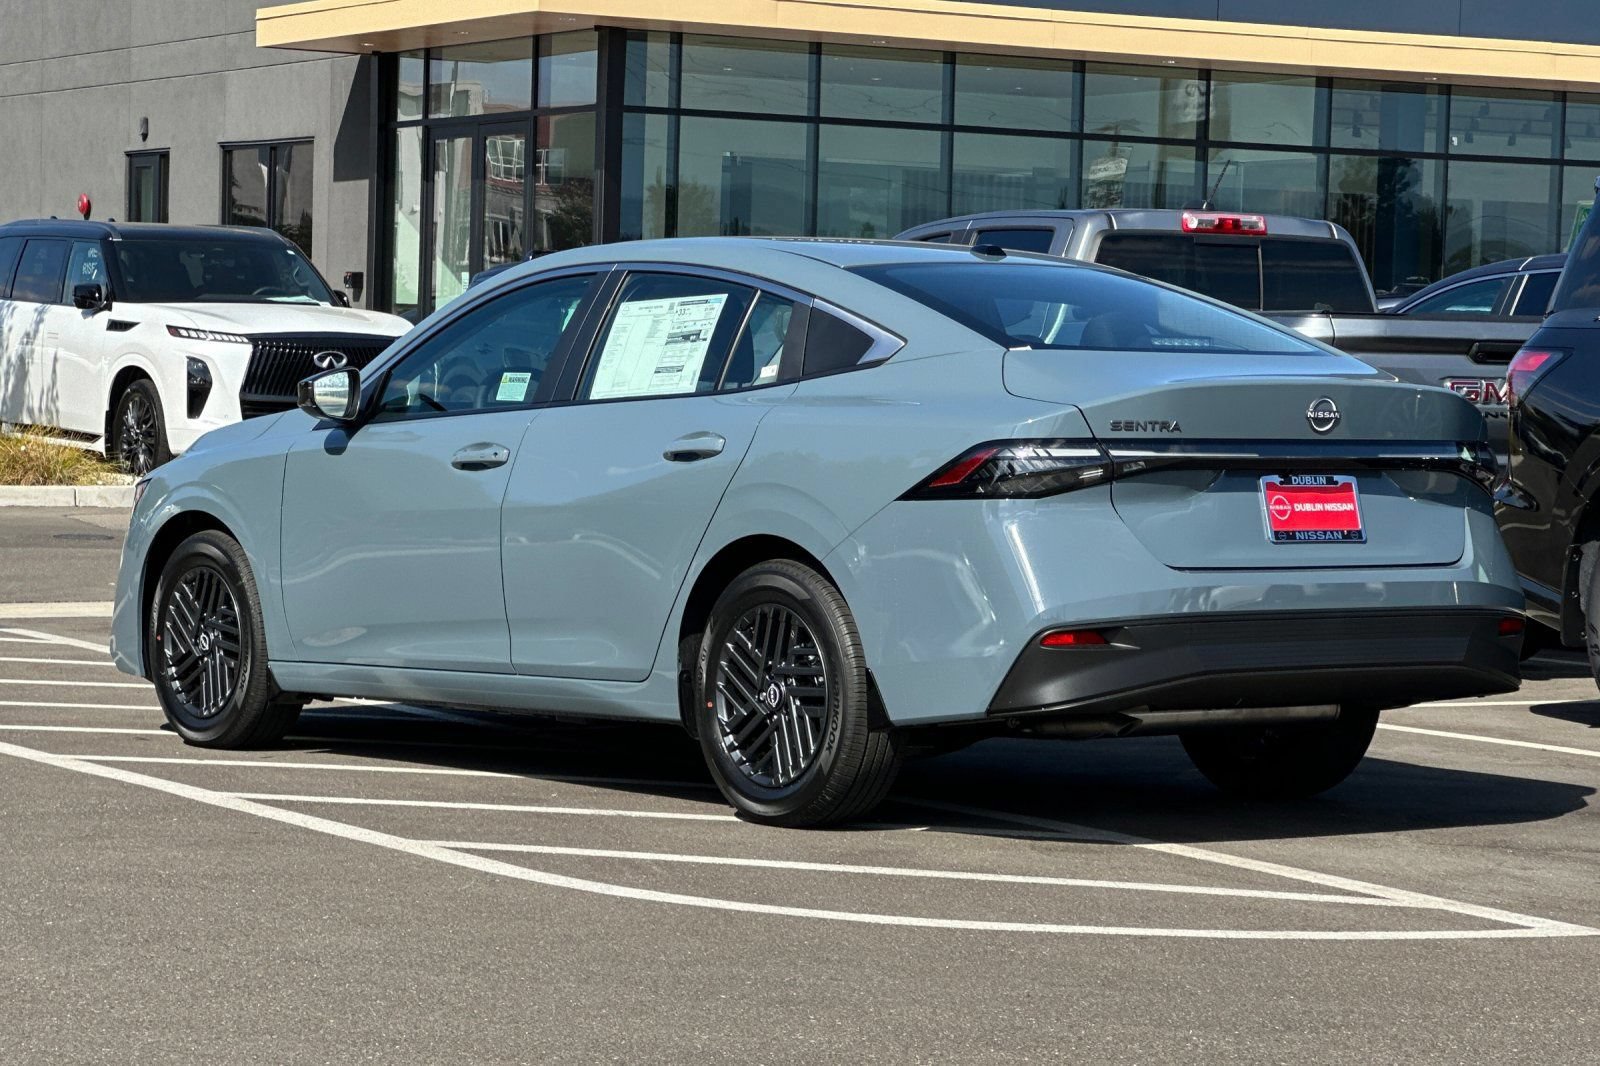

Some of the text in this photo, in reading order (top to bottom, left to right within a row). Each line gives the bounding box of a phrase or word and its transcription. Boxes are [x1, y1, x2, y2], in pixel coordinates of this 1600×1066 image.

[1443, 379, 1509, 404] GM
[1110, 420, 1182, 433] SENTRA
[1291, 476, 1326, 485] DUBLIN
[1294, 503, 1354, 511] DUBLIN NISSAN
[1295, 531, 1343, 540] NISSAN
